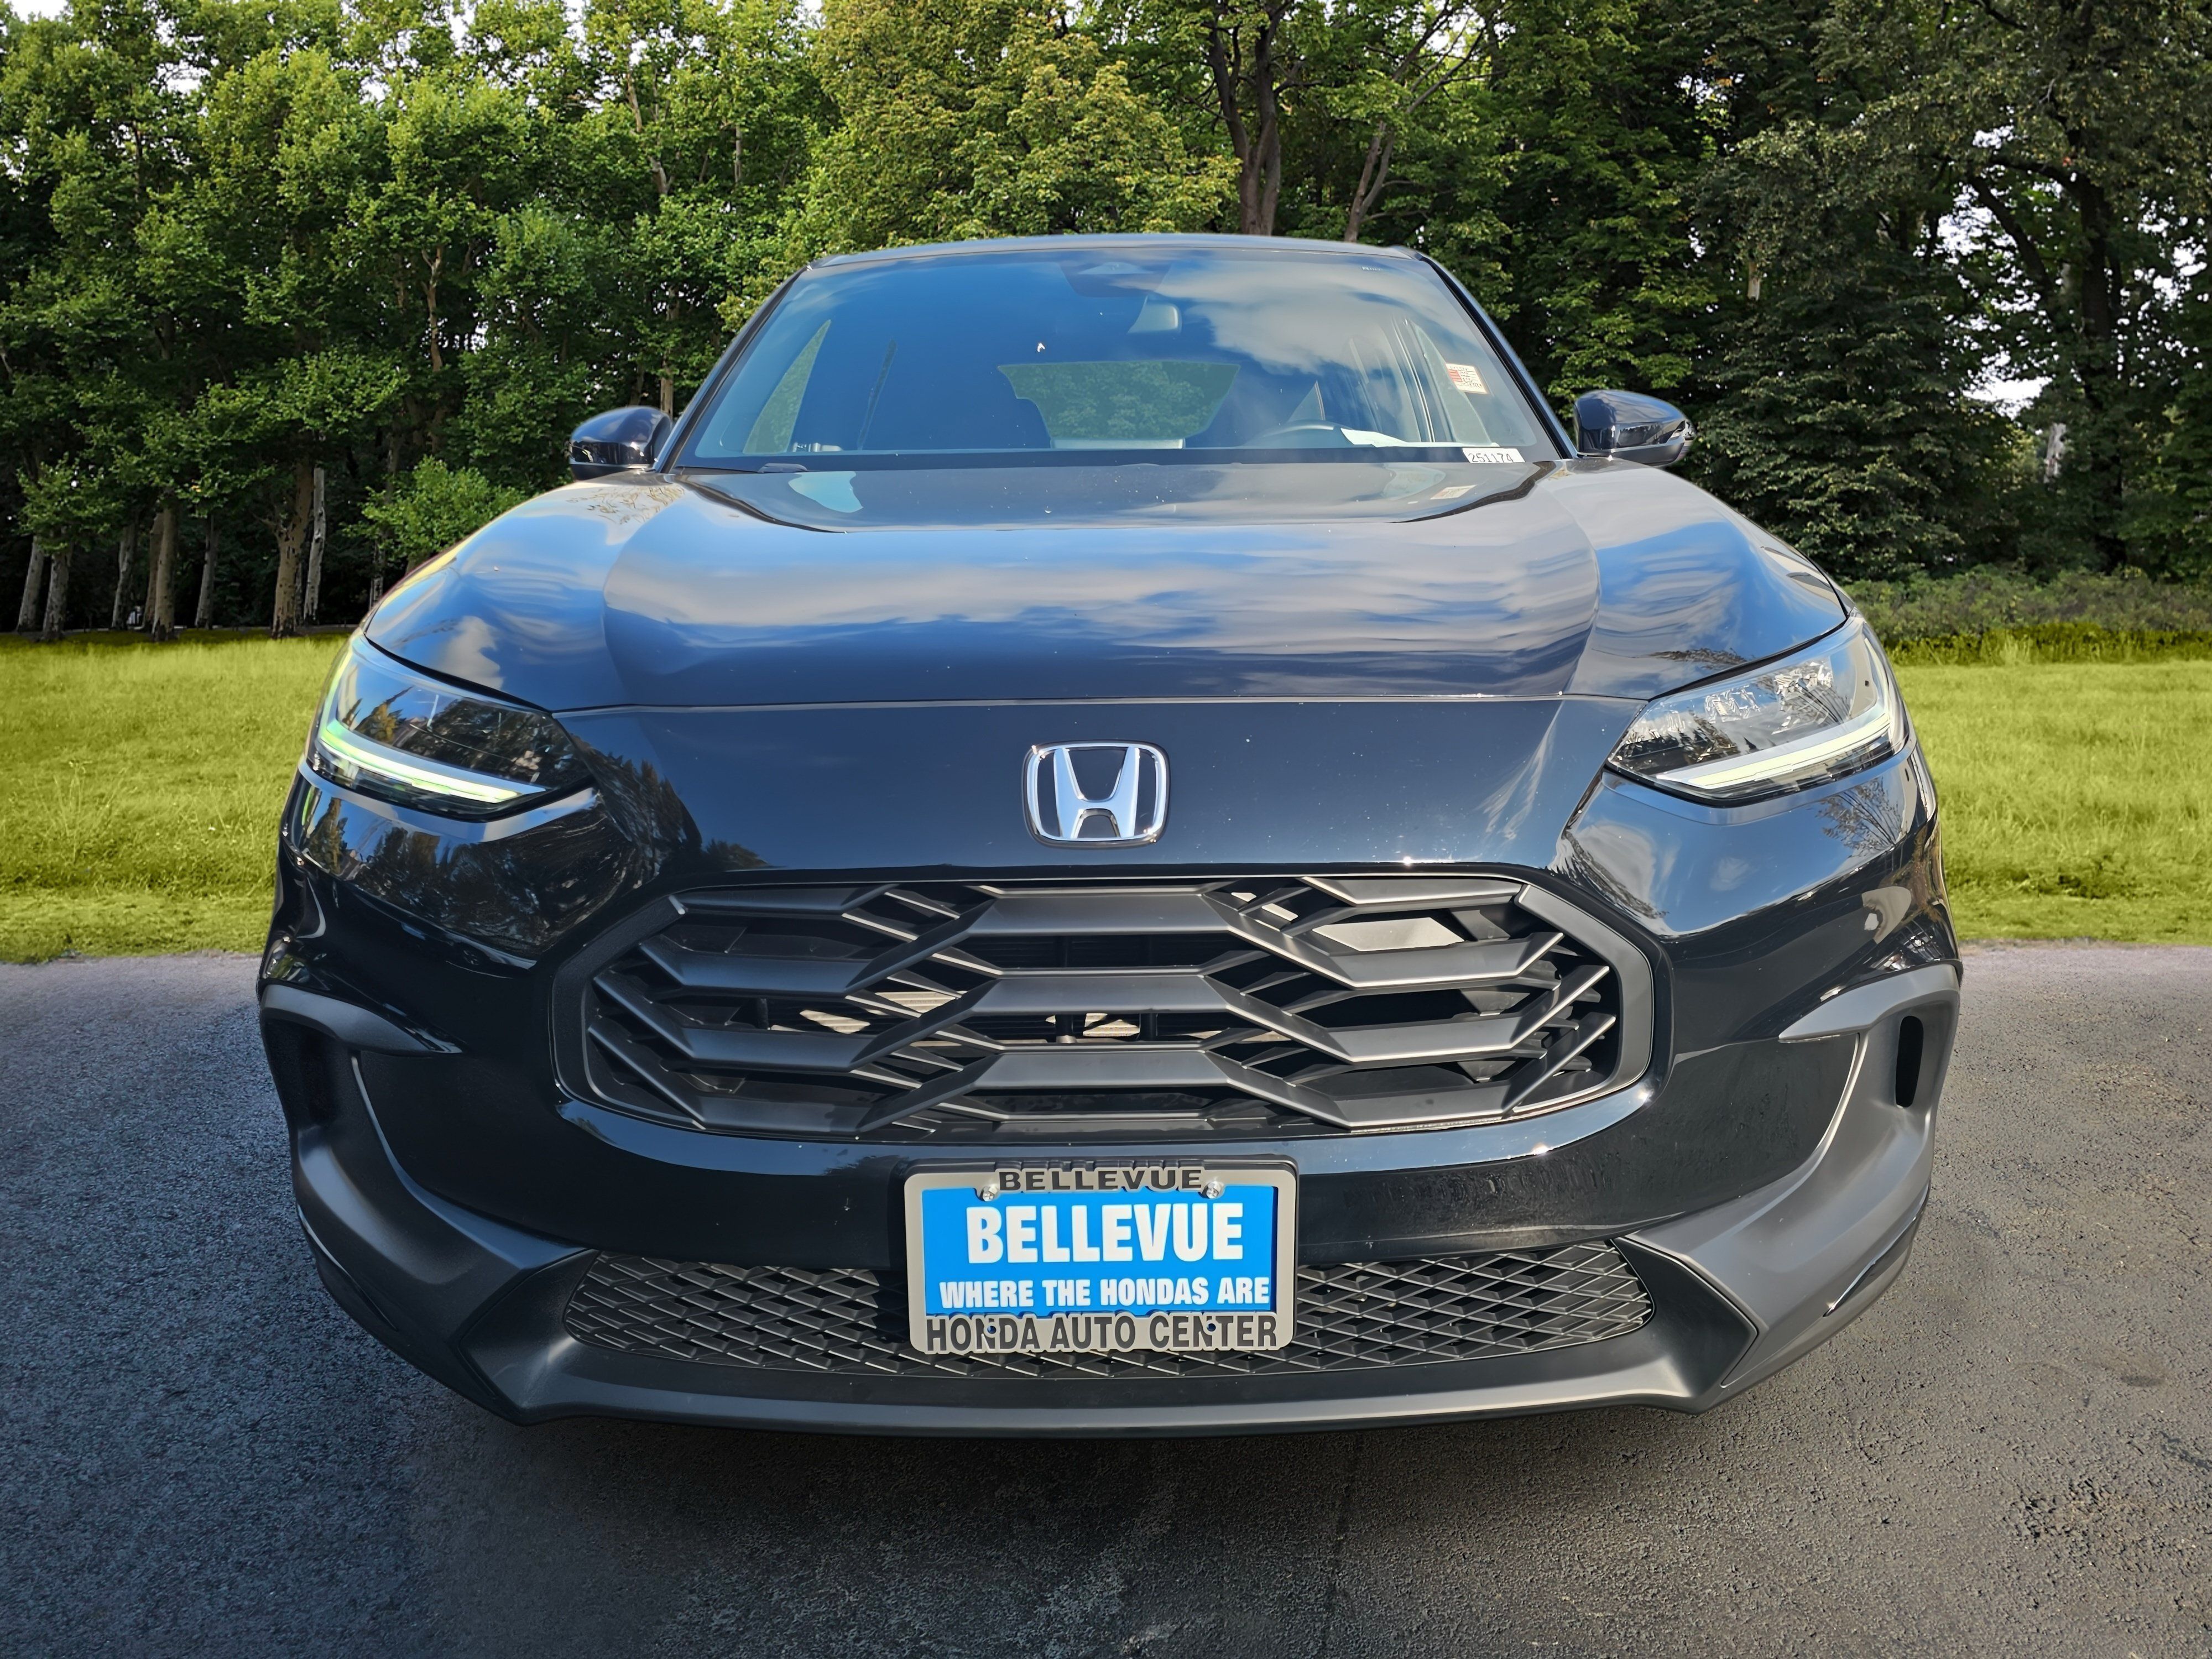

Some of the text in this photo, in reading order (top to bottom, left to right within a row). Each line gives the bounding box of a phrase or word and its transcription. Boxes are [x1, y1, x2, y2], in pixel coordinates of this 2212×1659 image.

[1468, 453, 1514, 463] 251174
[999, 1169, 1202, 1191] BELLEVUE
[966, 1203, 1244, 1264] BELLEVUE
[939, 1276, 1270, 1309] WHERE THE HONDAS ARE
[926, 1314, 1277, 1352] HONDA AUTO CENTER
